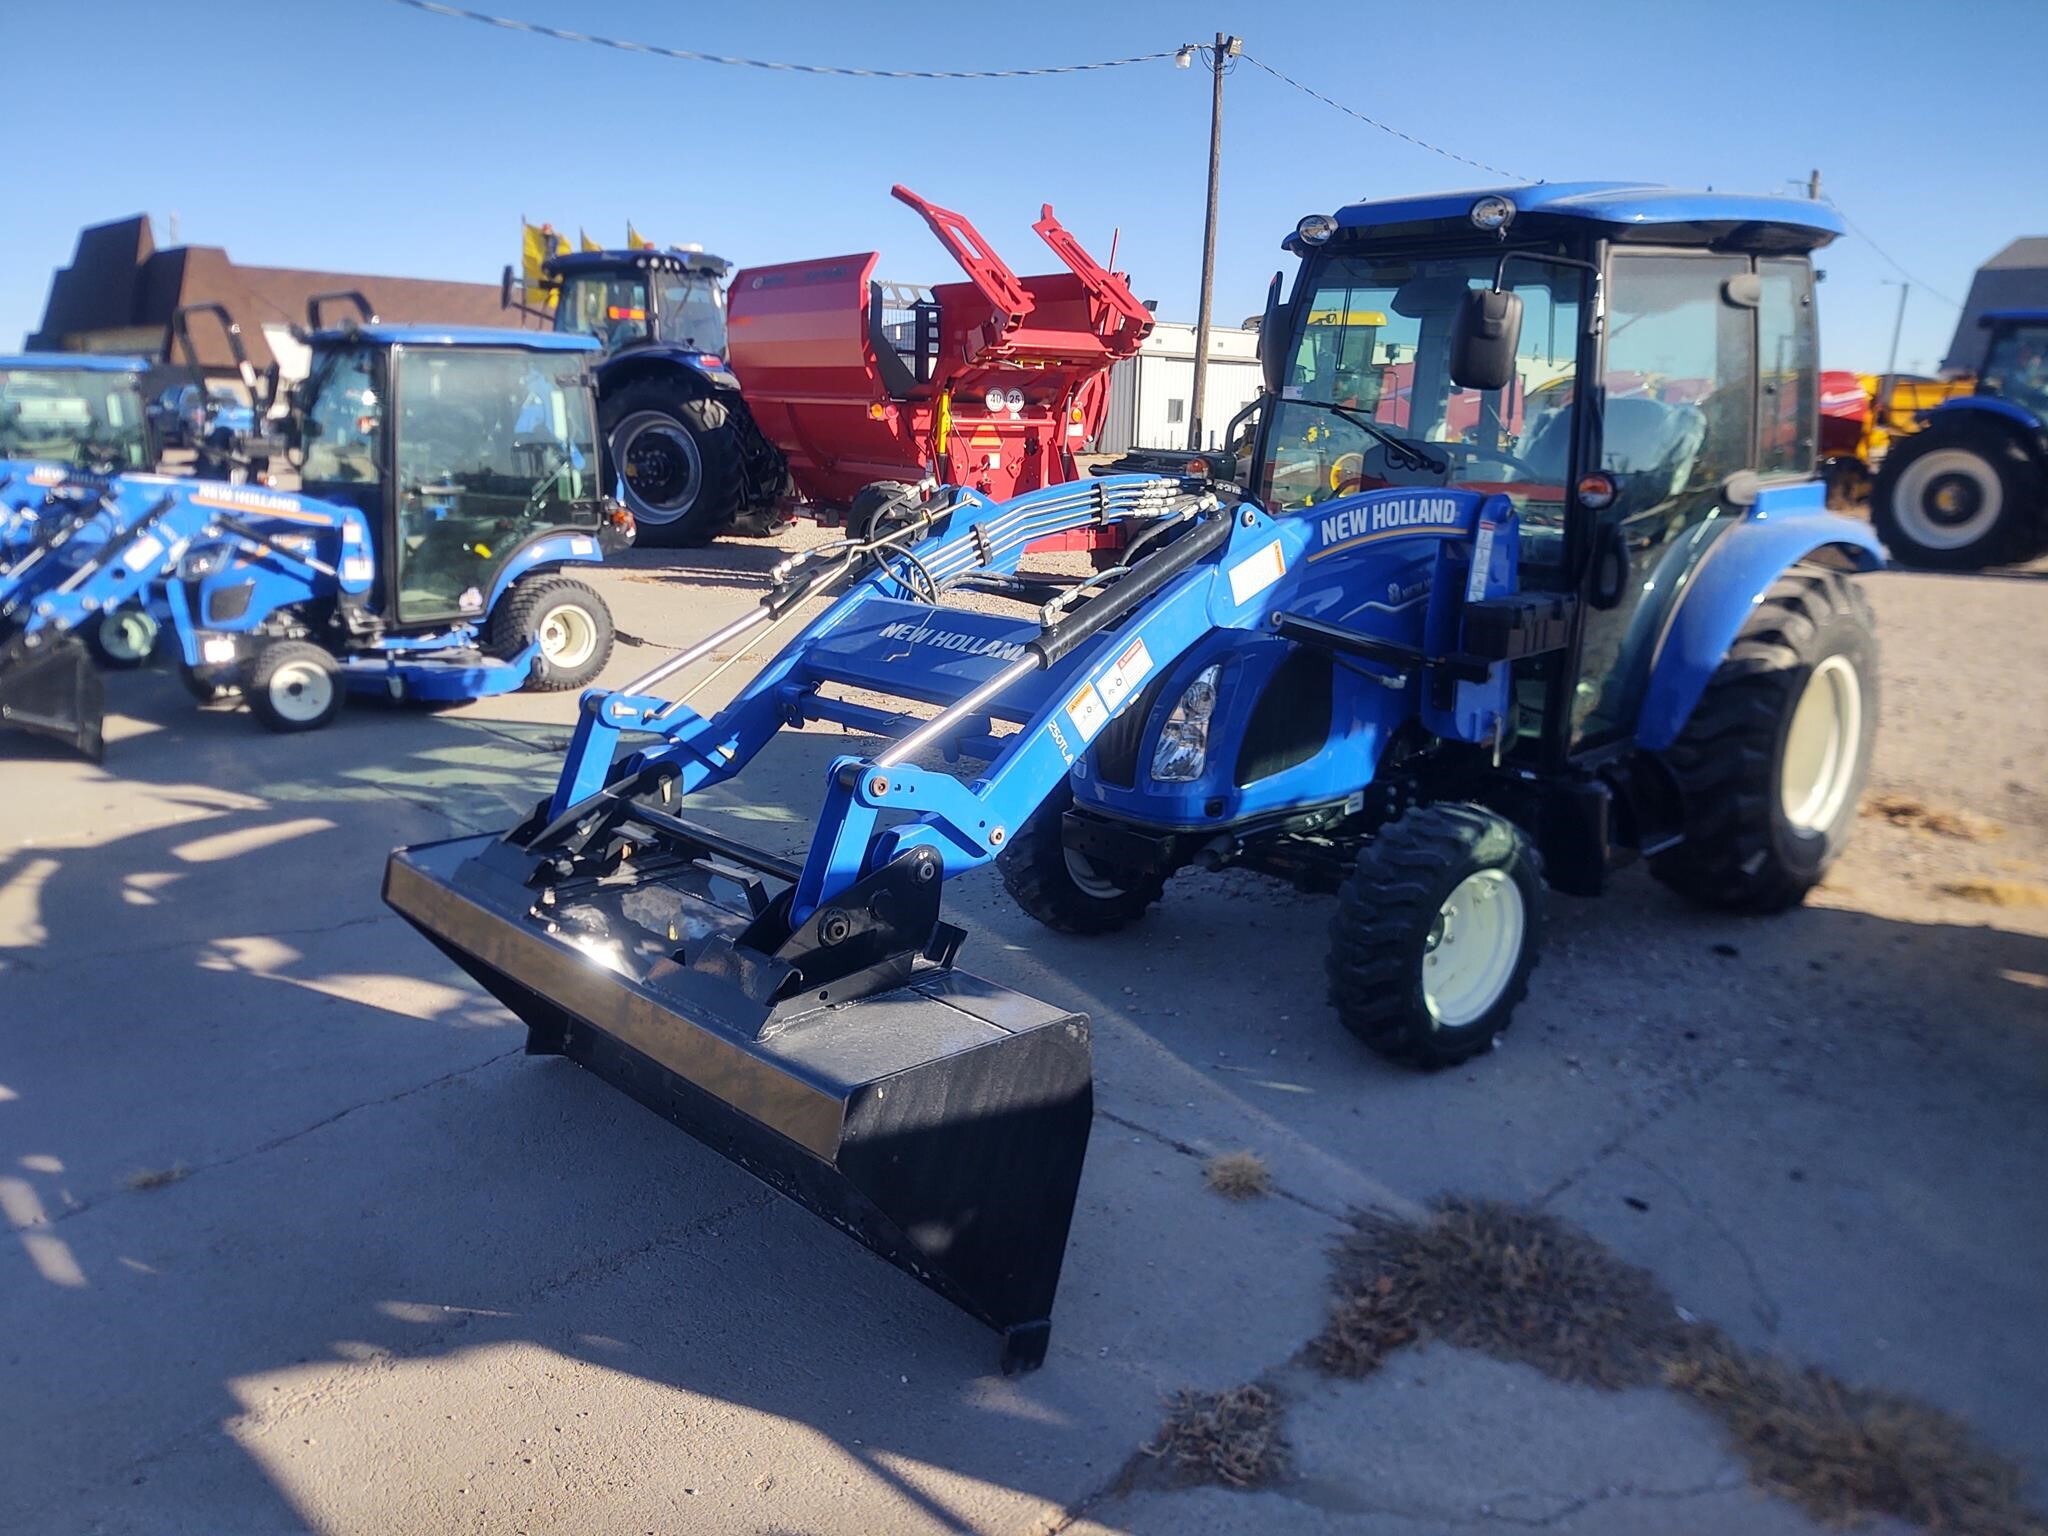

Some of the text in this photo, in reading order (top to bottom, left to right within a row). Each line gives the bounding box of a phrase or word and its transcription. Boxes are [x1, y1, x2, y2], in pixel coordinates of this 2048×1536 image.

[1009, 395, 1021, 404] 25
[199, 483, 233, 503] NEW
[1321, 498, 1457, 546] NEW HOLLAND
[878, 622, 937, 643] NEW
[1047, 720, 1075, 767] 250TLA
